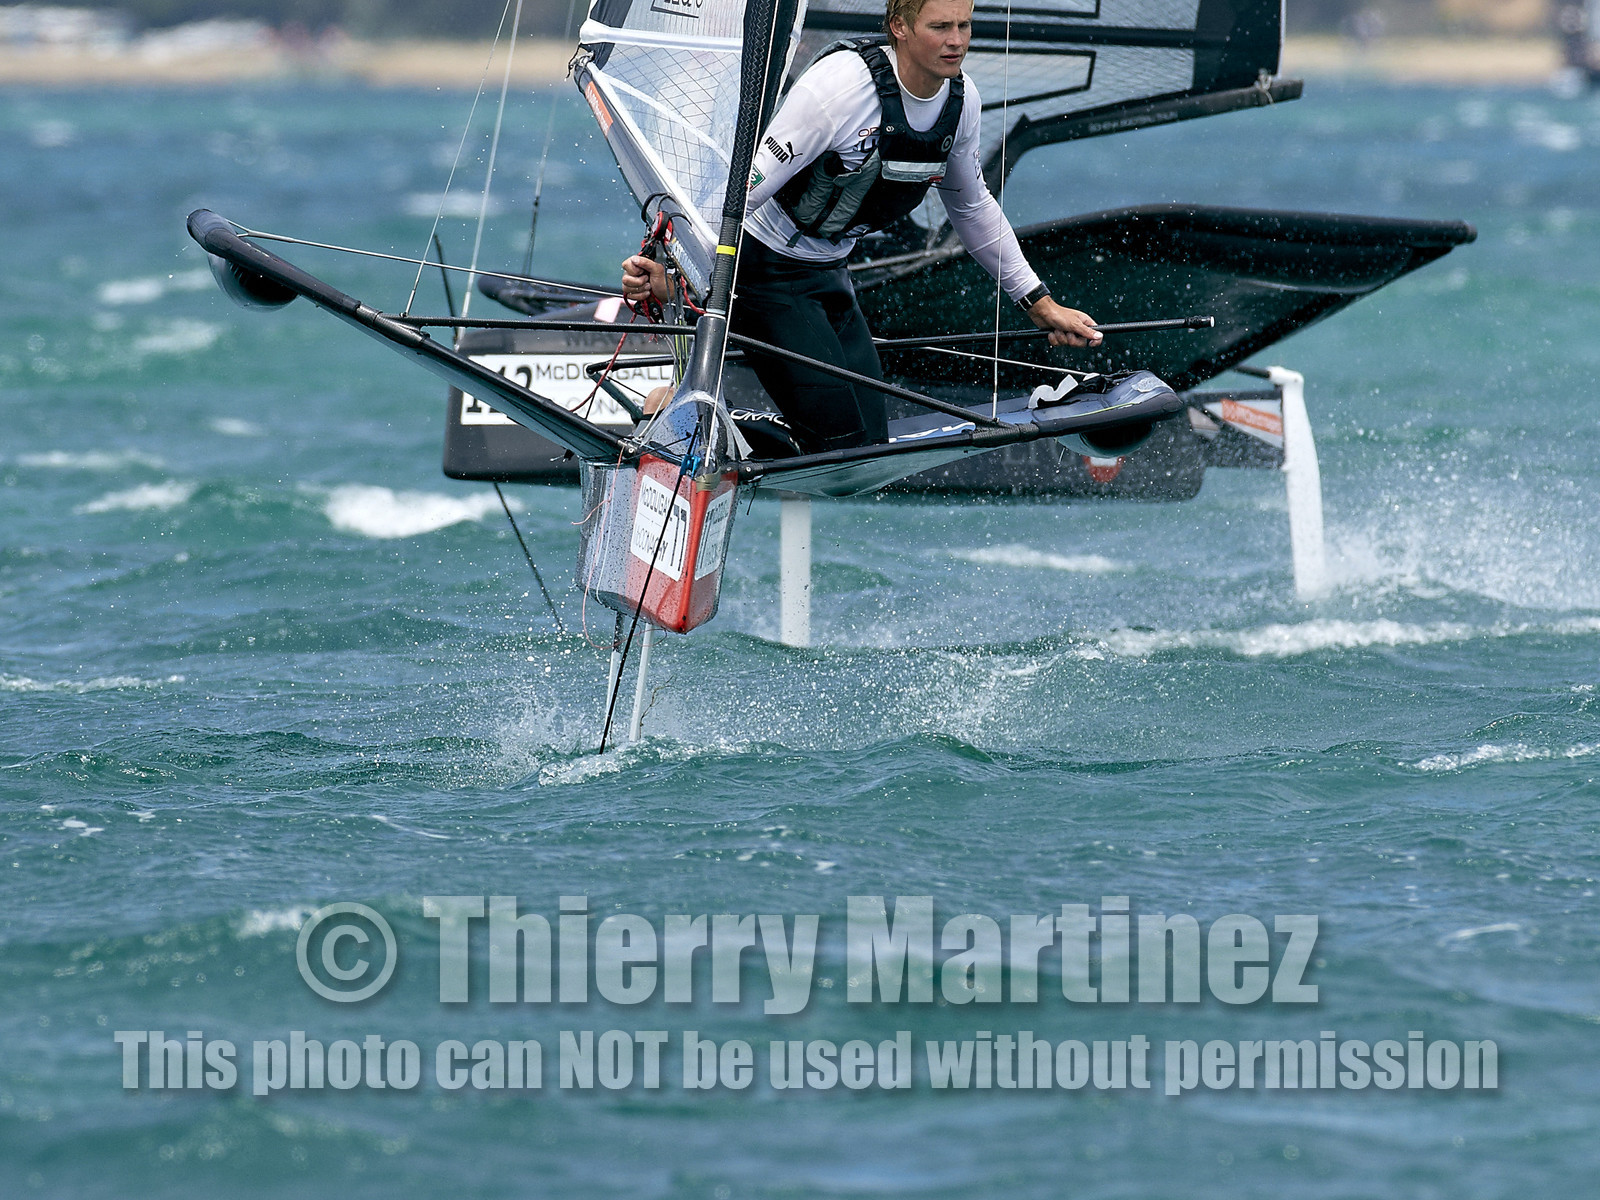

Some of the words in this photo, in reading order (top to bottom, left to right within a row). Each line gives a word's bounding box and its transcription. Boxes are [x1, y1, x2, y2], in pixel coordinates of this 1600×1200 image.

[764, 135, 790, 164] PUMA
[535, 362, 671, 381] McDGALL
[730, 409, 792, 430] ORAC
